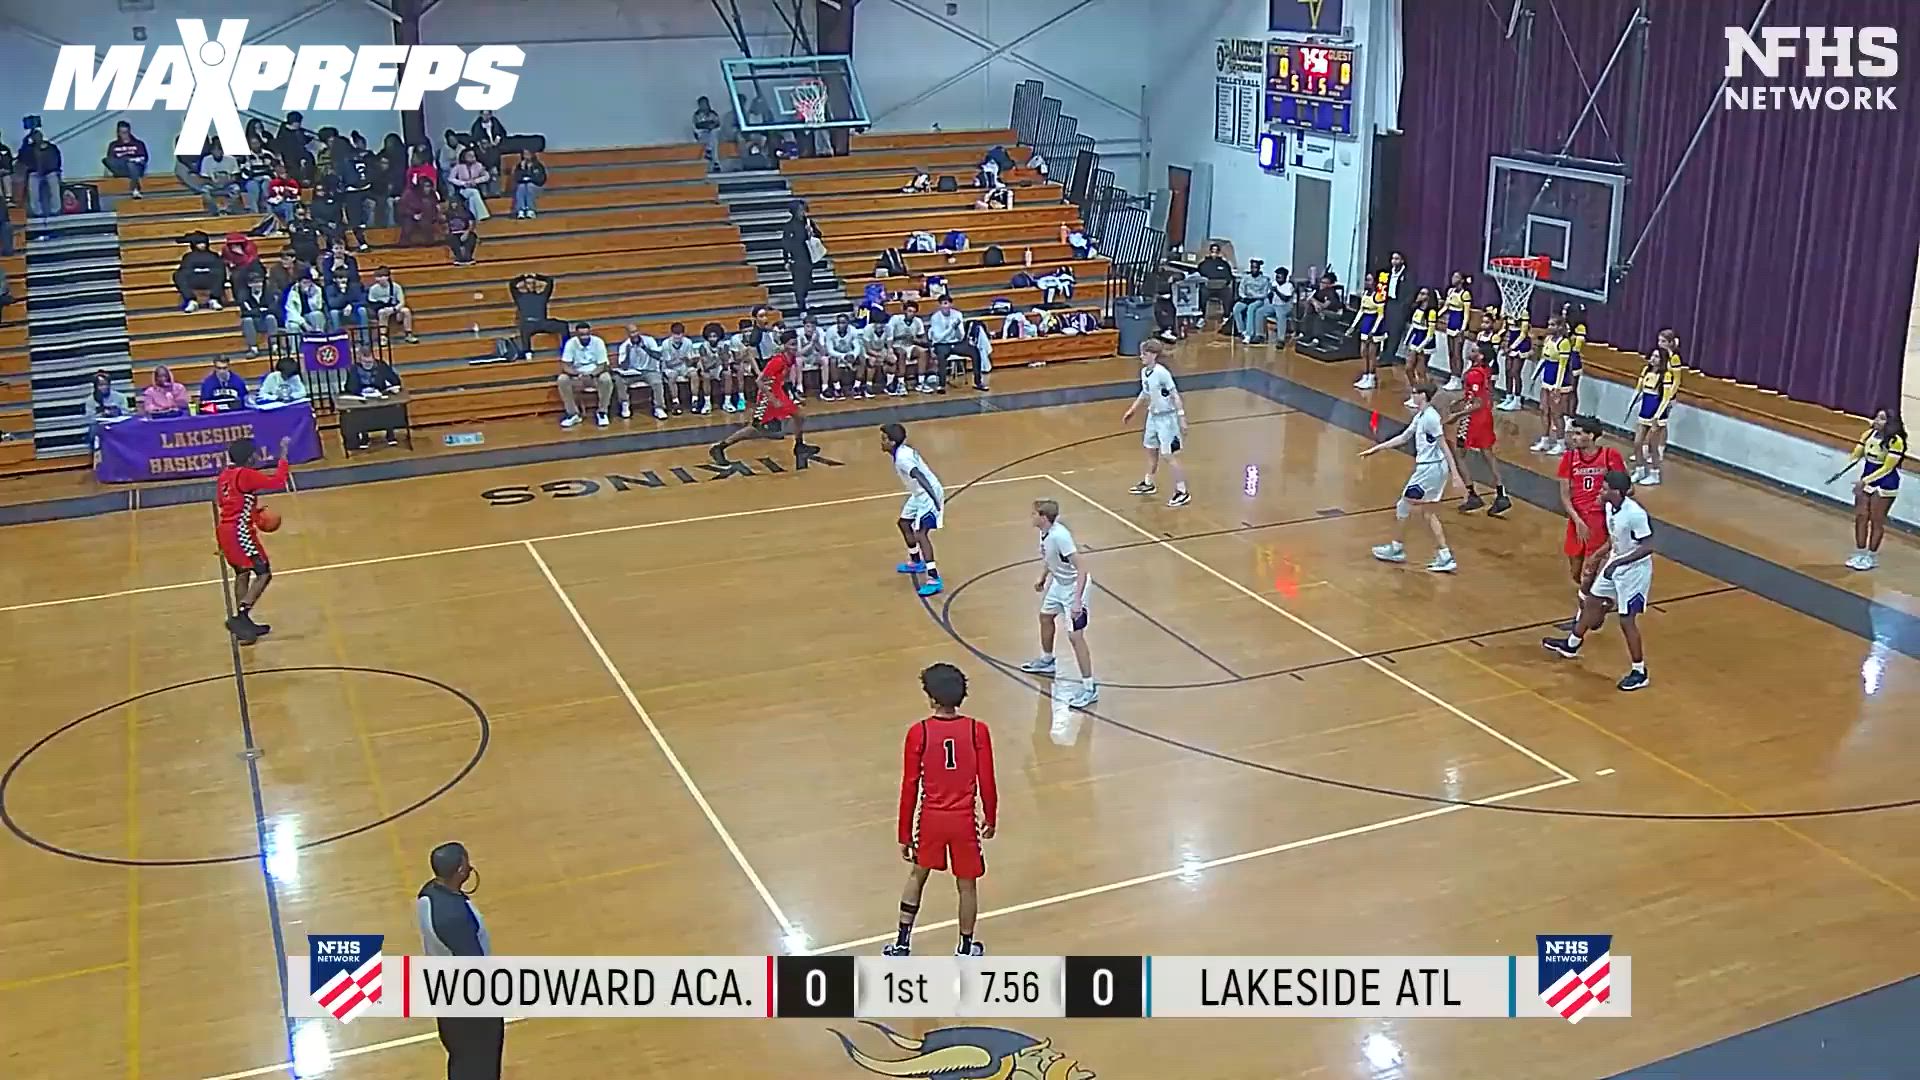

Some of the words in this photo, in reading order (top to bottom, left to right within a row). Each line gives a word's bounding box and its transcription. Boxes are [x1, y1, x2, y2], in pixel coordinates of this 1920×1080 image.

[160, 424, 255, 449] LAKESIDE
[1583, 475, 1595, 491] 0
[943, 738, 957, 770] 1
